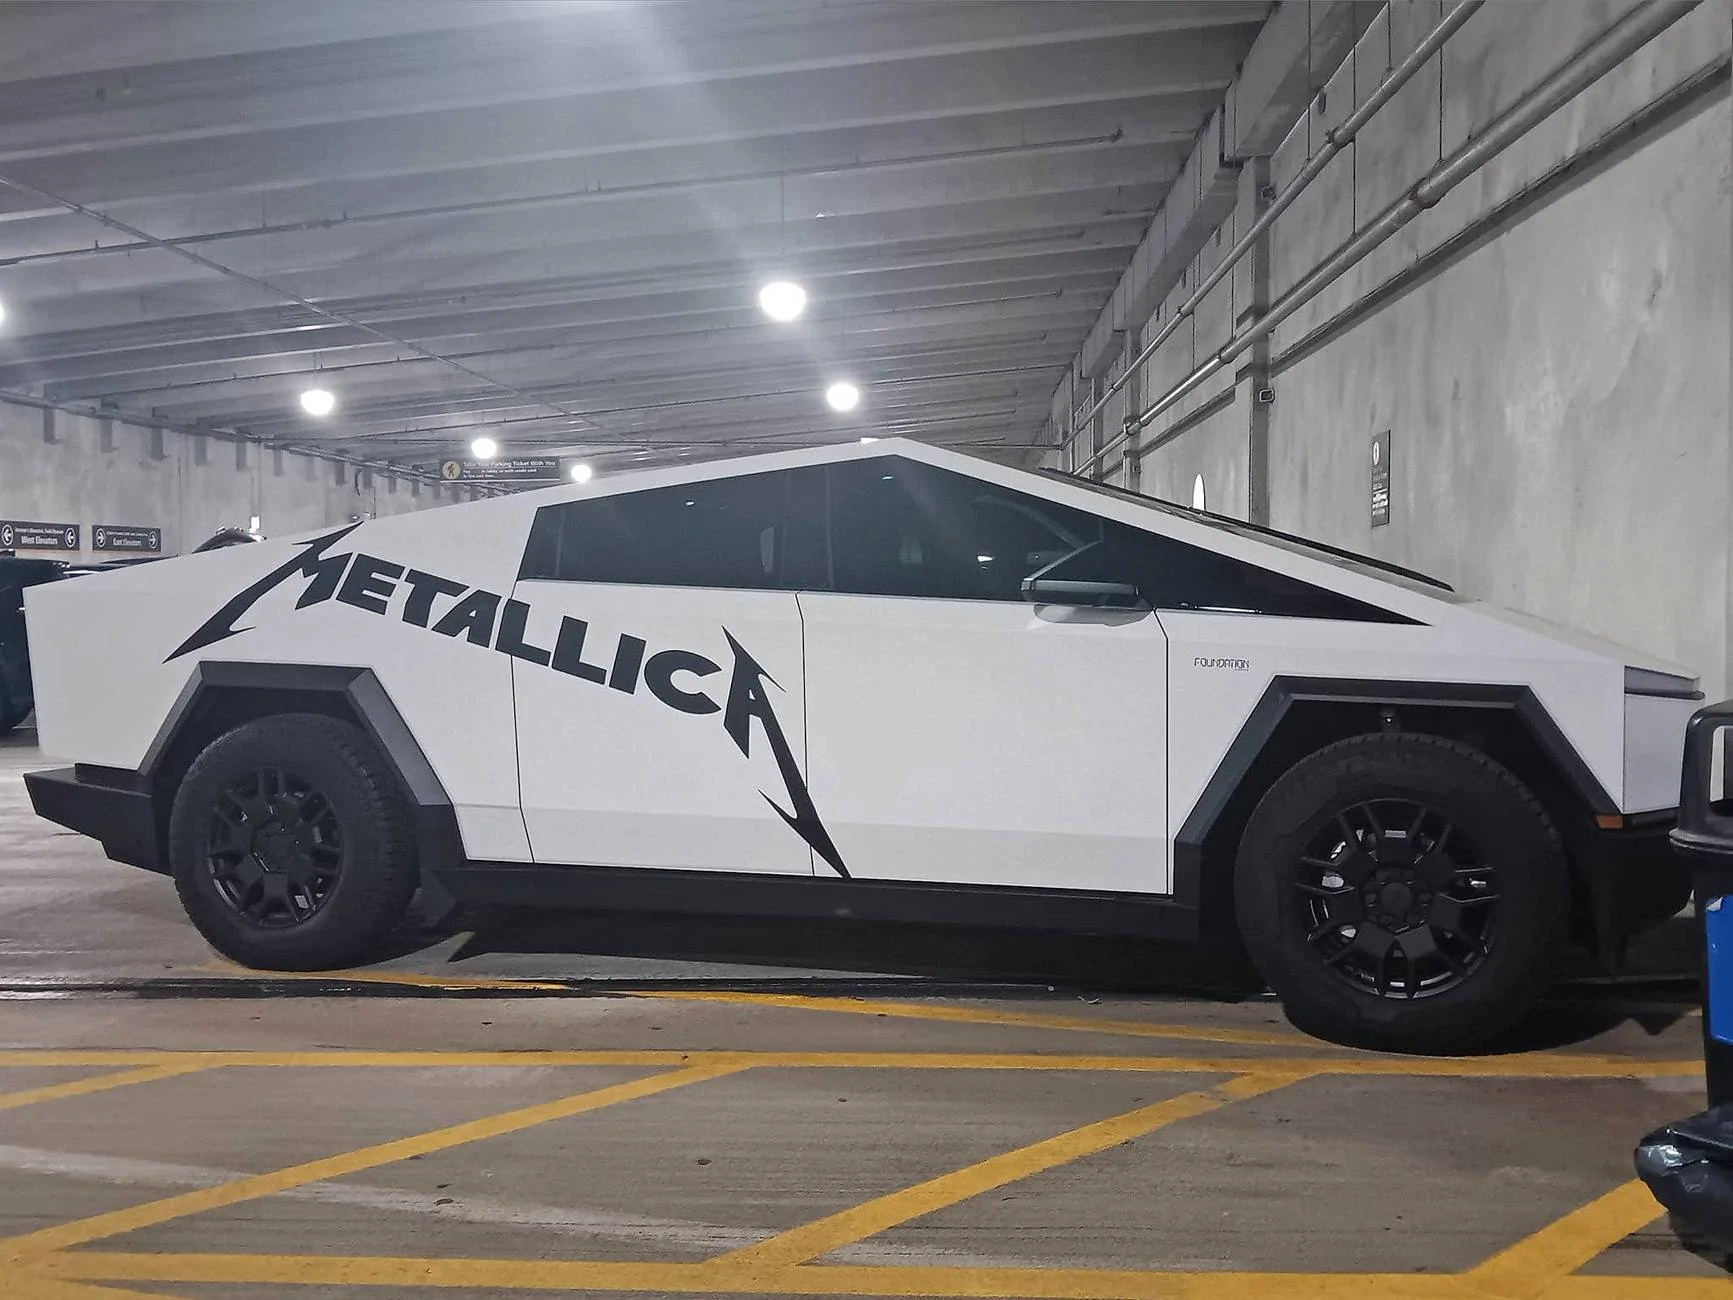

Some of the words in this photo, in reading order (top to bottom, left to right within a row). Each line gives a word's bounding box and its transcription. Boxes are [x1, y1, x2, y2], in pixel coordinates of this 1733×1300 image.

[21, 536, 35, 544] West
[36, 536, 58, 545] Elevators
[1194, 657, 1249, 669] FOUNDATION
[162, 521, 851, 879] METALLICA
